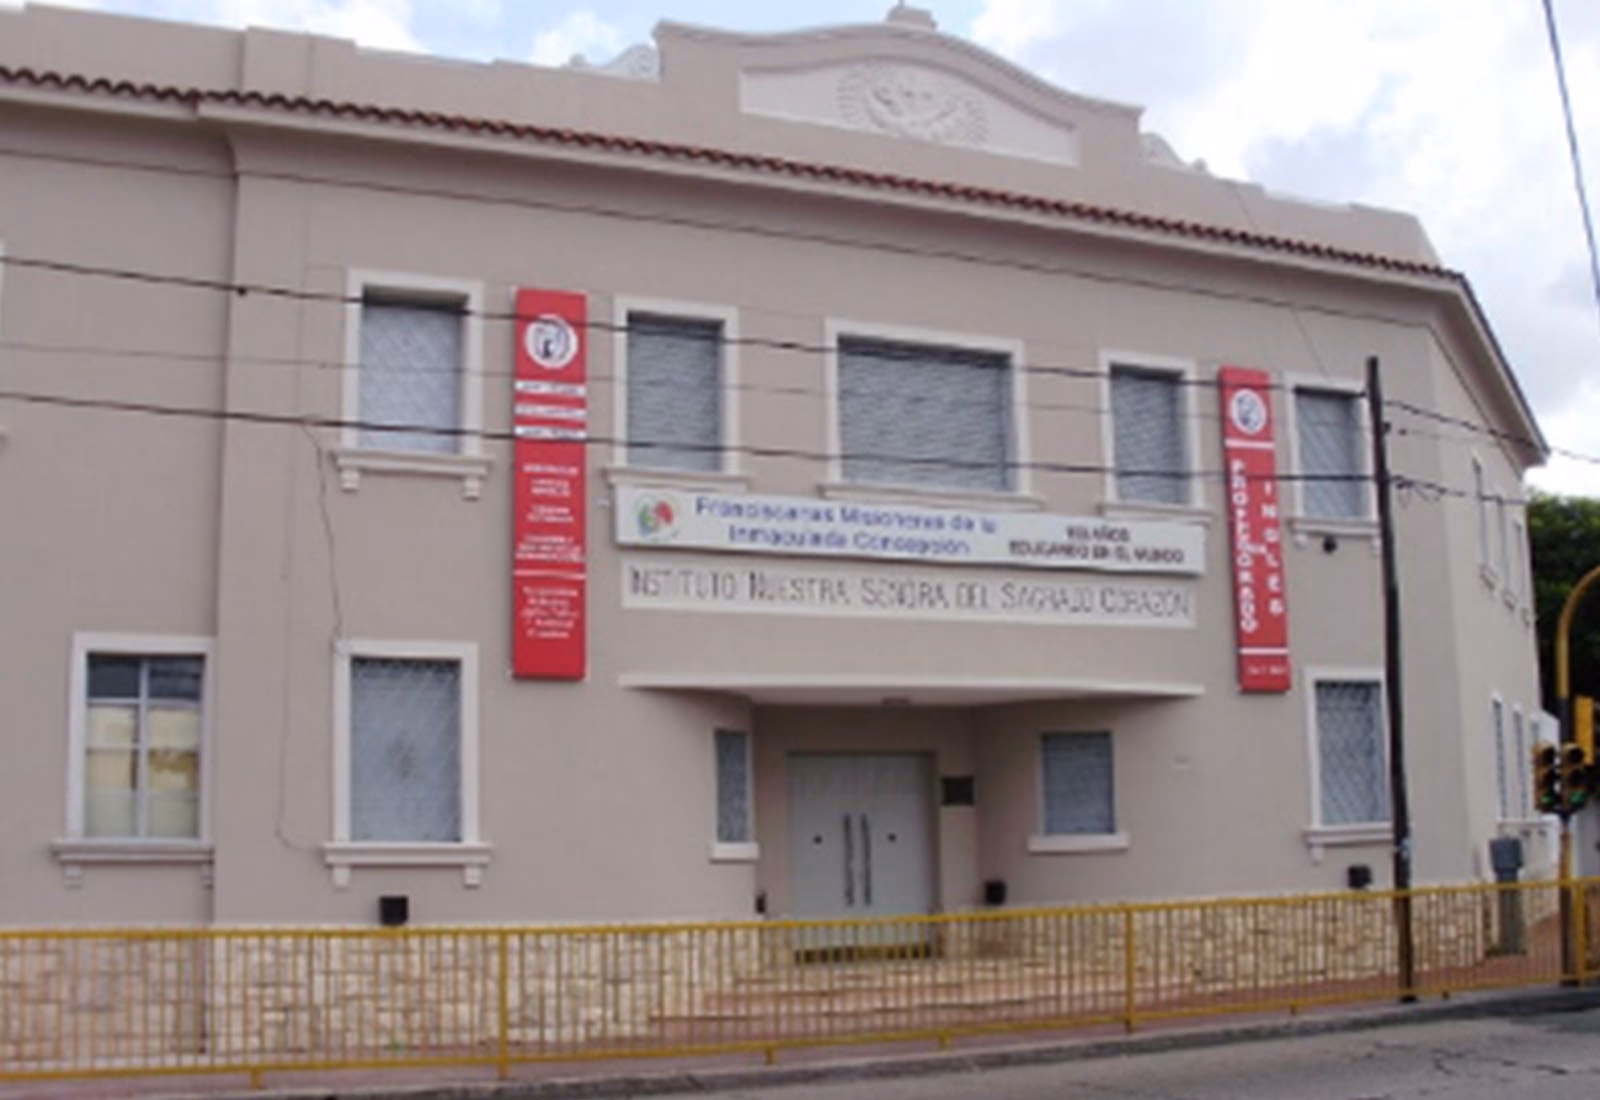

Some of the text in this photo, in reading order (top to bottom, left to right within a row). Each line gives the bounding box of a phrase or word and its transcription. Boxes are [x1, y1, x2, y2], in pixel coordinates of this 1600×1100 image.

[951, 514, 974, 532] de
[1134, 548, 1185, 564] MUNDO
[630, 566, 736, 600] INSTITUTO
[956, 581, 987, 610] DEL
